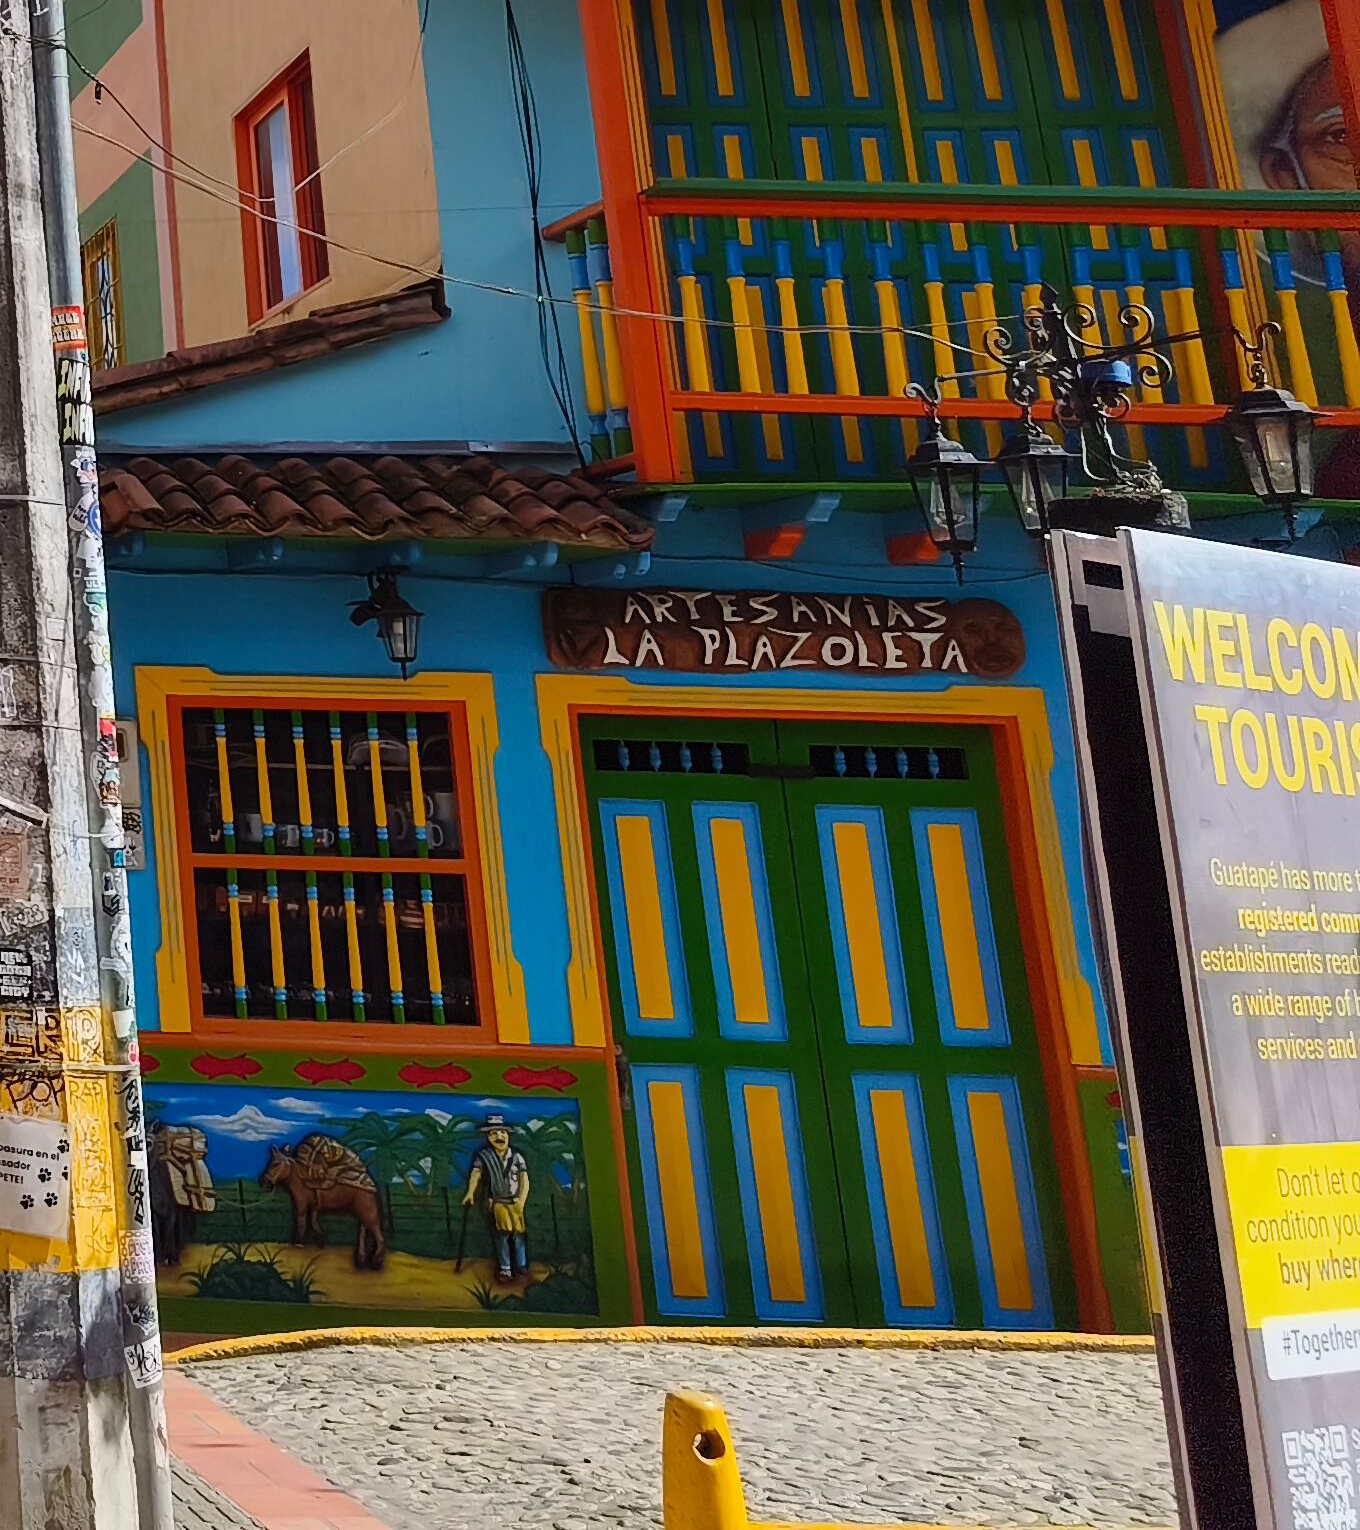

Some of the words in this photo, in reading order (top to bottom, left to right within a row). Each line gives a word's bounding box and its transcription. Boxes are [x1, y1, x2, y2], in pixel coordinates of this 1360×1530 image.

[602, 627, 665, 667] LA
[690, 626, 969, 674] PLAZOLETA
[1210, 857, 1279, 894] Guatapé
[1280, 861, 1311, 890] has
[1313, 869, 1353, 893] more
[1237, 901, 1319, 937] registered
[1200, 943, 1323, 974] establishments
[1231, 993, 1243, 1016] a
[1245, 987, 1285, 1017] wide
[1287, 993, 1333, 1023] range
[1335, 989, 1352, 1017] of
[1257, 1032, 1324, 1060] services
[1327, 1030, 1357, 1059] and
[36, 1151, 48, 1159] en
[51, 1152, 60, 1161] el
[1276, 1165, 1320, 1199] Don't
[1324, 1165, 1347, 1195] let
[1246, 1209, 1330, 1244] condition
[1278, 1251, 1312, 1291] buy
[1282, 1324, 1360, 1361] #Together
